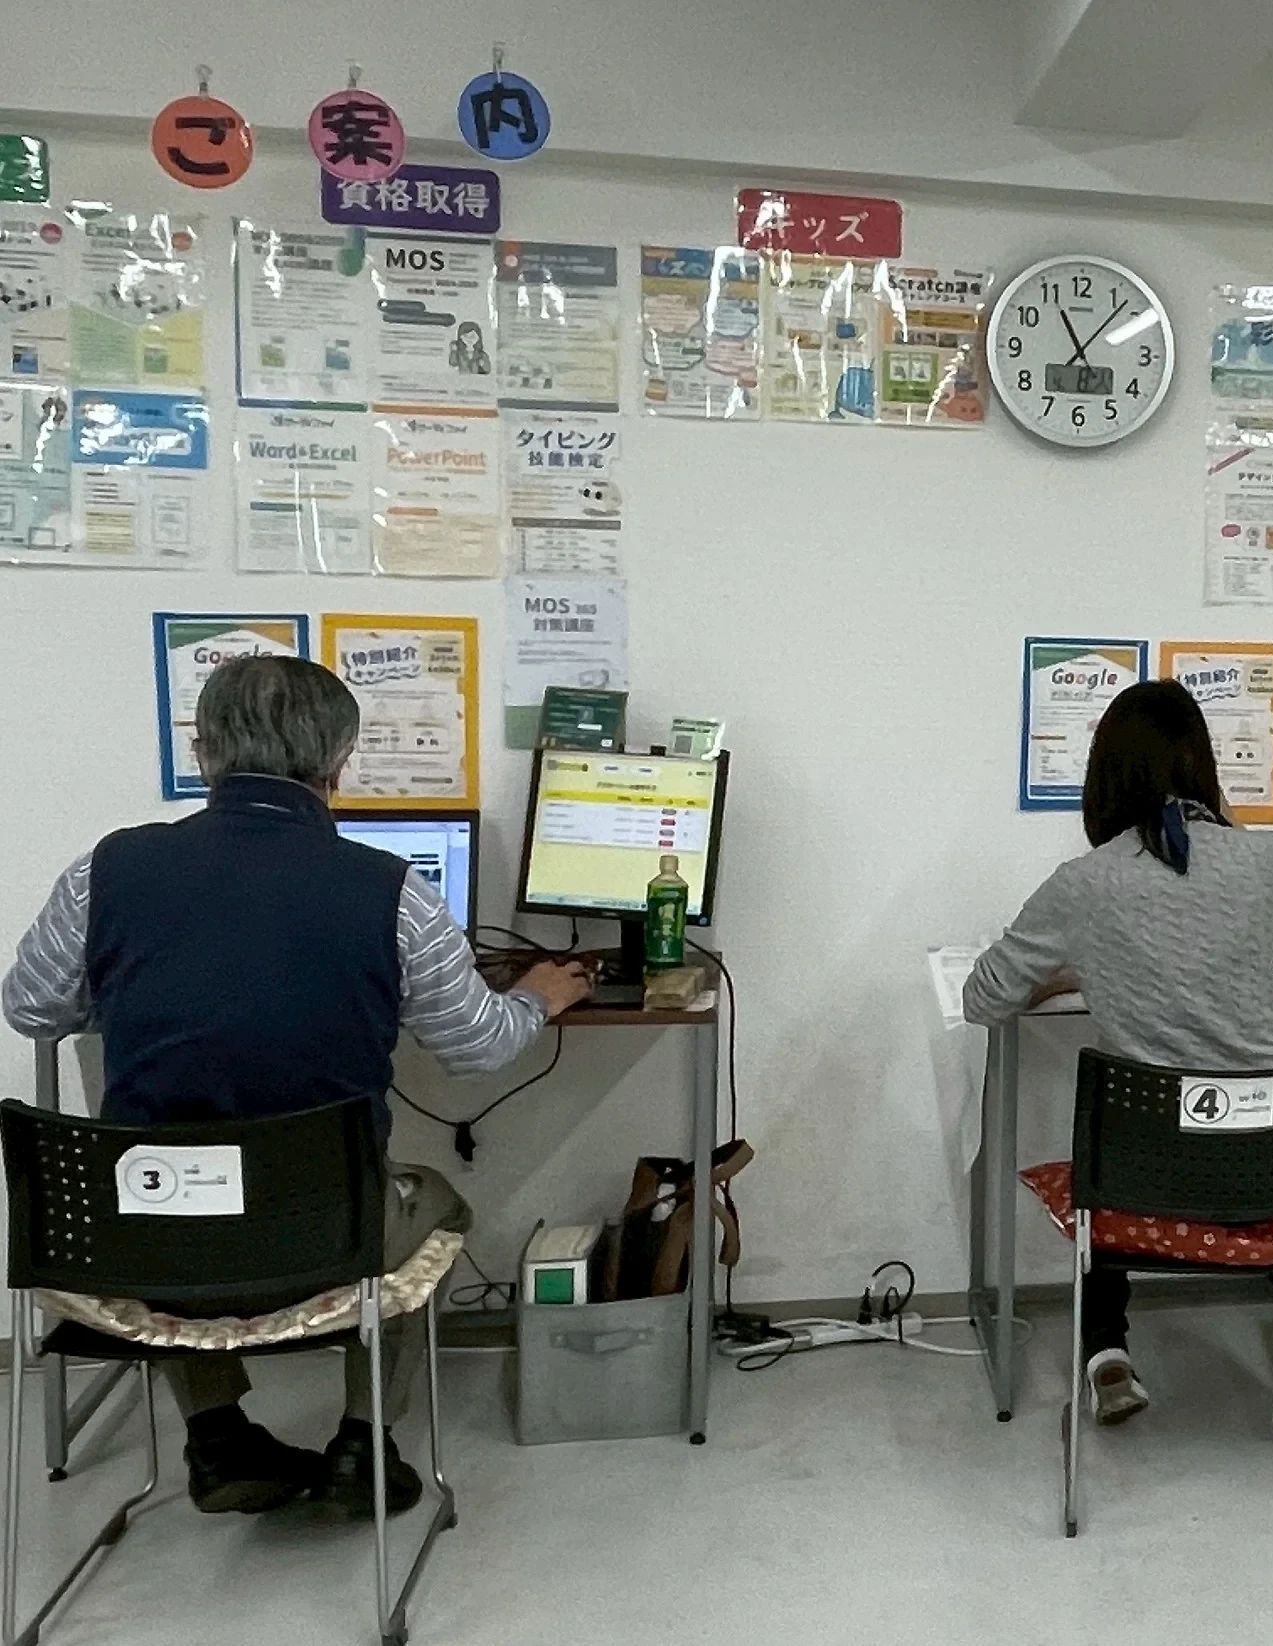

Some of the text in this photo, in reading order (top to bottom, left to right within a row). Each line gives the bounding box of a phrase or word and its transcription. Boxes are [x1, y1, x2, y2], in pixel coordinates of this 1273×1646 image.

[321, 100, 392, 166] 案
[470, 81, 540, 149] 内
[337, 177, 490, 219] 資格取得
[386, 248, 445, 272] MOS
[1041, 282, 1060, 304] 11
[1072, 276, 1092, 299] 12
[1110, 287, 1117, 309] 1
[1018, 306, 1039, 328] 10
[1008, 336, 1022, 358] 9
[1138, 345, 1151, 367] 3
[1018, 370, 1032, 391] 8
[1126, 378, 1140, 400] 4
[1041, 396, 1055, 417] 7
[1071, 405, 1085, 427] 6
[1105, 399, 1118, 420] 5
[516, 429, 617, 450] タイピング
[525, 597, 570, 614] MOS
[1051, 668, 1118, 690] Google
[1192, 1088, 1220, 1120] 4
[142, 1170, 162, 1190] 3
